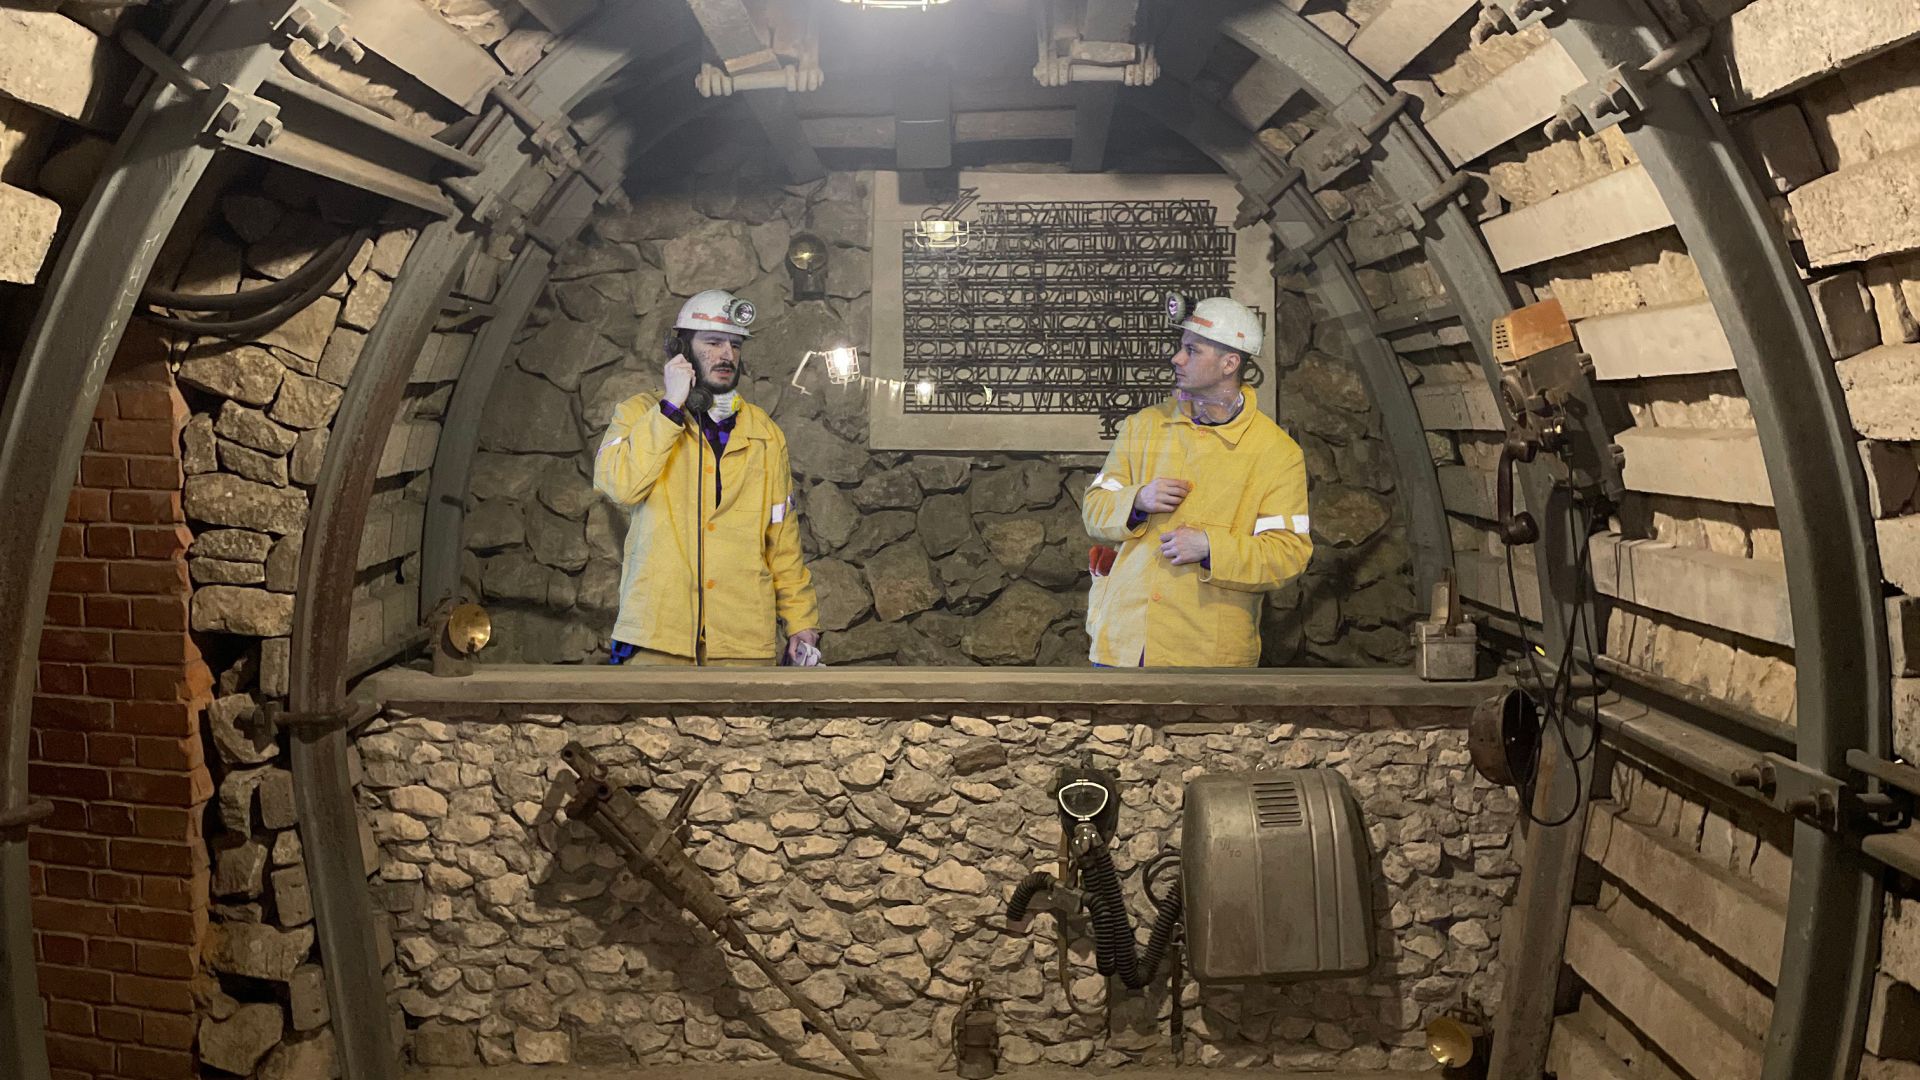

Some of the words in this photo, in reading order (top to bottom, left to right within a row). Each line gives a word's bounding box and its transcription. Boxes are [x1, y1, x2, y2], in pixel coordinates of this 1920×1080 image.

[904, 336, 958, 361] POD
[963, 336, 1090, 361] NADZOREM
[1027, 361, 1125, 387] AKADEMII
[1031, 386, 1055, 413] W
